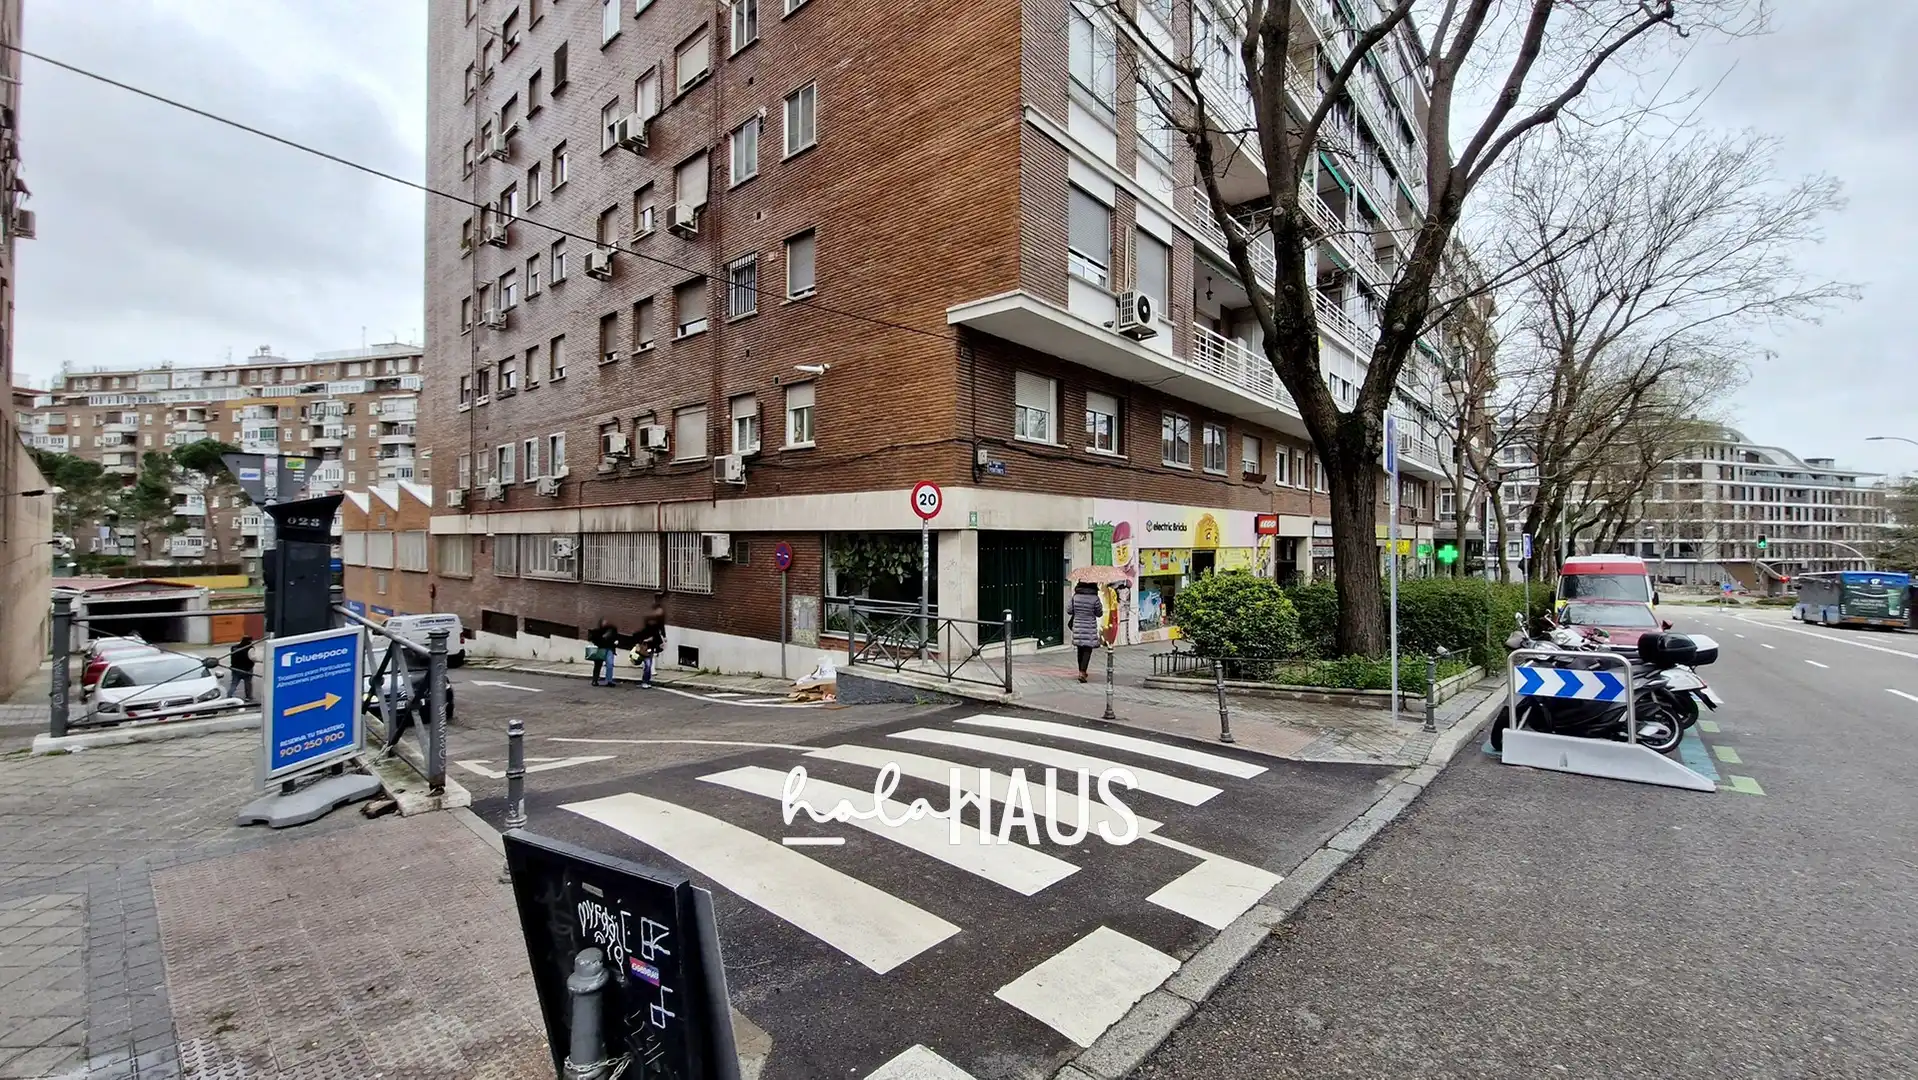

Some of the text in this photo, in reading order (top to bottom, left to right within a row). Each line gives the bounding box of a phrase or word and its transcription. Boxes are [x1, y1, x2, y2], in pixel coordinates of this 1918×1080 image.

[919, 493, 937, 506] 20
[1153, 521, 1173, 532] electric
[1259, 520, 1277, 528] LEGO
[295, 647, 349, 664] bluespace
[307, 731, 316, 739] TU
[280, 731, 345, 758] 900 250 900
